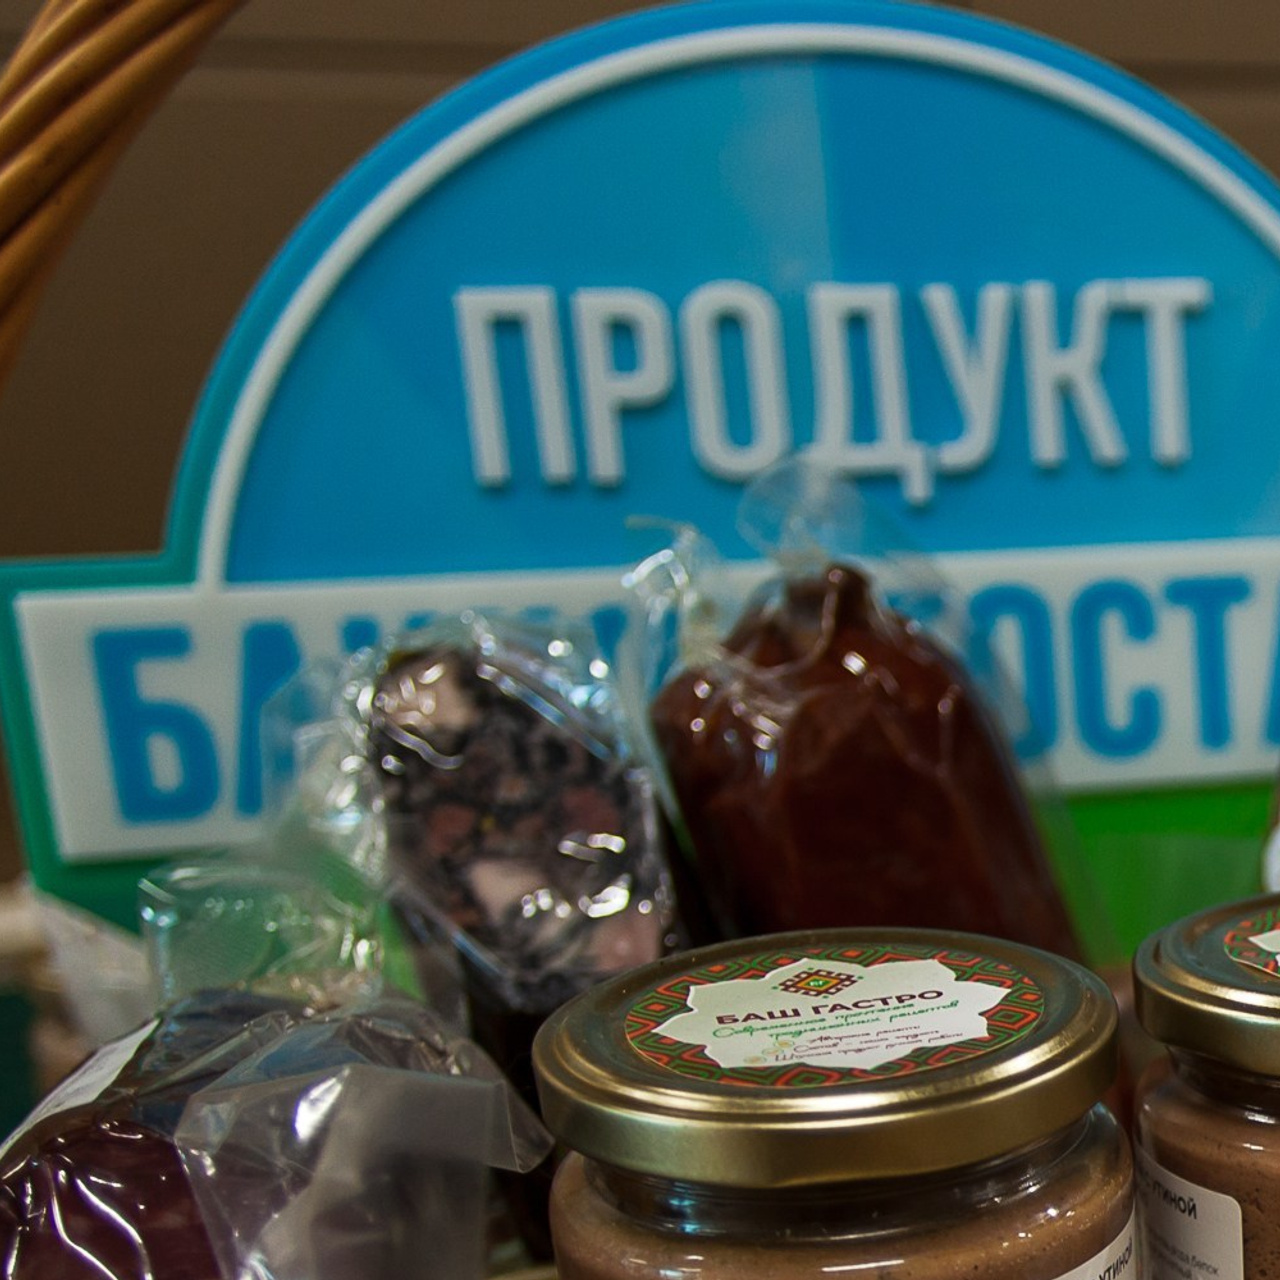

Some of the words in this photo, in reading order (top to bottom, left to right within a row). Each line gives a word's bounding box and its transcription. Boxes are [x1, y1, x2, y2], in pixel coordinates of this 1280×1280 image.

[454, 278, 1212, 505] ПРОДУКТ
[716, 1008, 801, 1025] БАШ
[812, 990, 944, 1015] ГАСТРО
